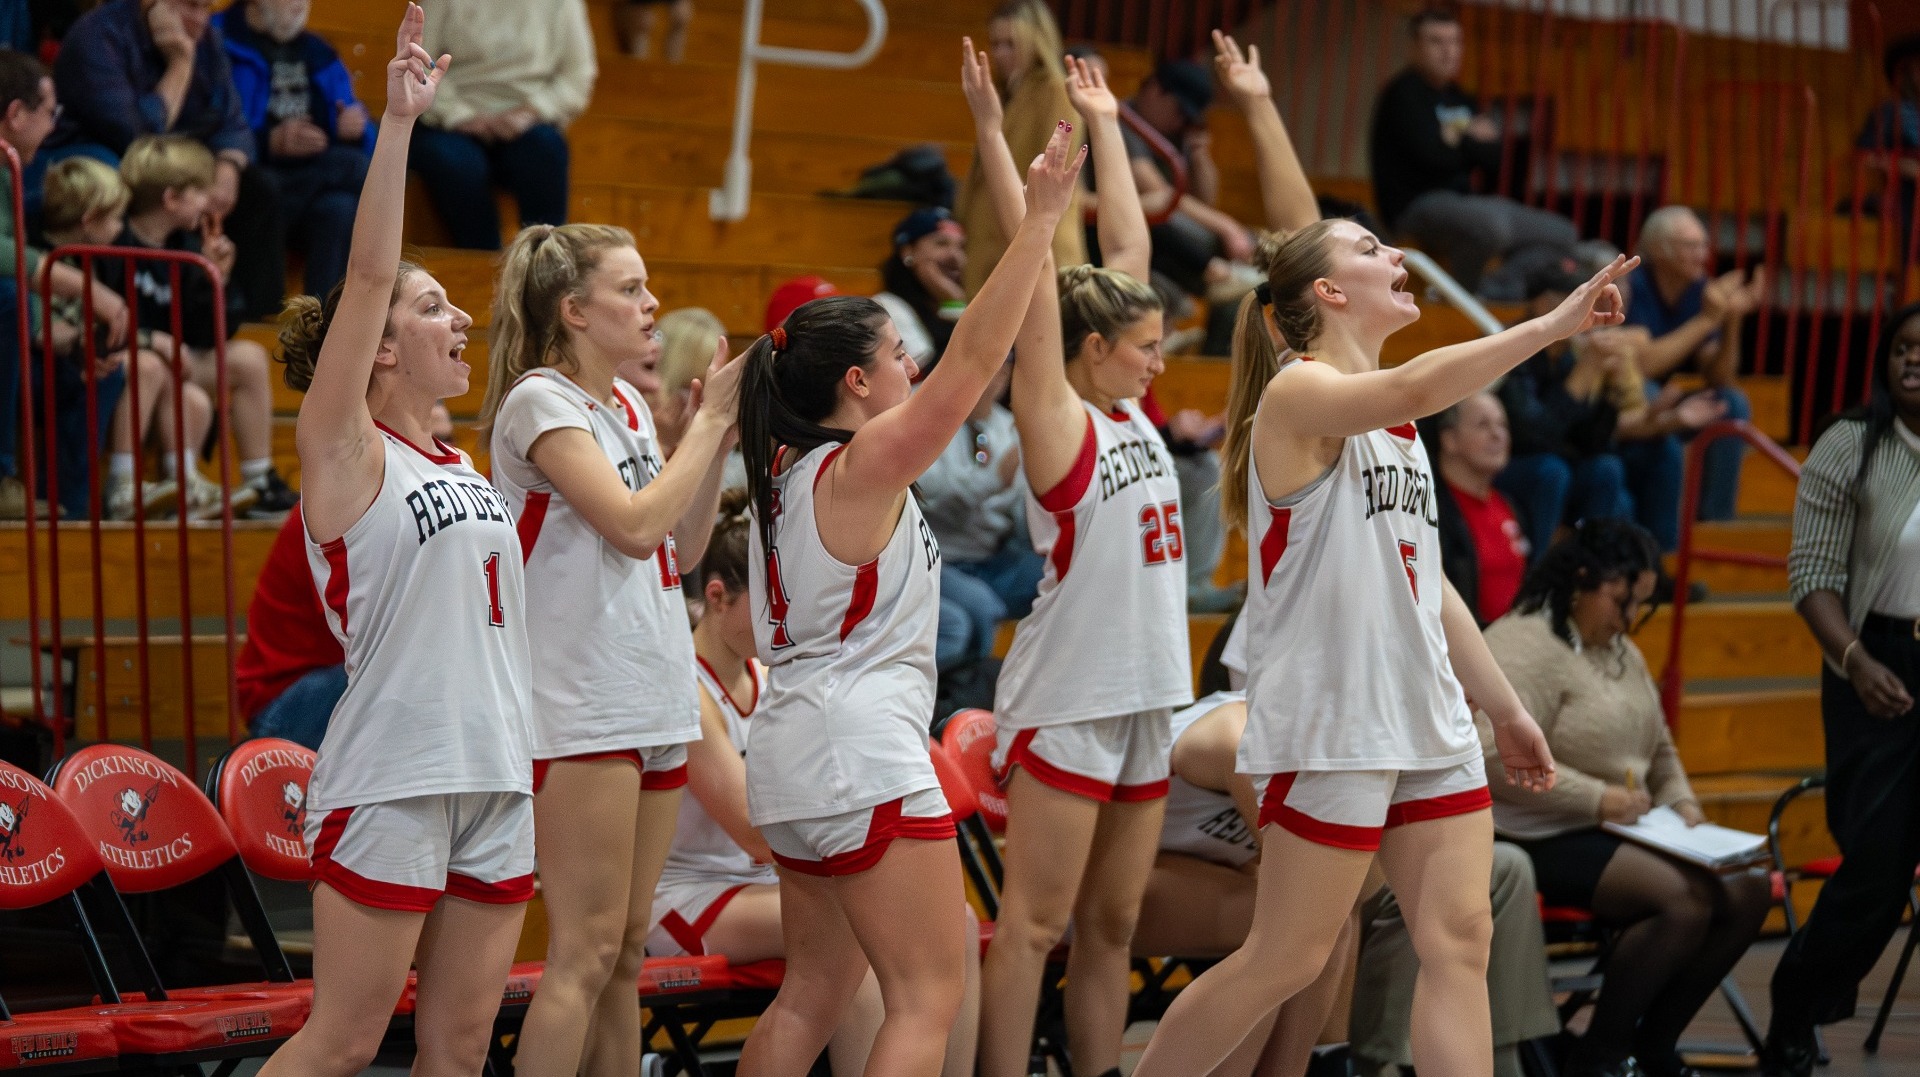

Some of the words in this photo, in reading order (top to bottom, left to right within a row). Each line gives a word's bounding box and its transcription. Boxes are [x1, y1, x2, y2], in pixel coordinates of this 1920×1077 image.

[1100, 441, 1140, 502] RED
[1362, 465, 1399, 520] RED
[405, 480, 467, 546] RED
[456, 482, 513, 527] DEV
[1138, 500, 1183, 567] 25
[484, 552, 504, 628] 1
[73, 755, 178, 793] DICKINSON
[240, 749, 315, 787] DICKINSO
[100, 832, 192, 869] ATHLETICS
